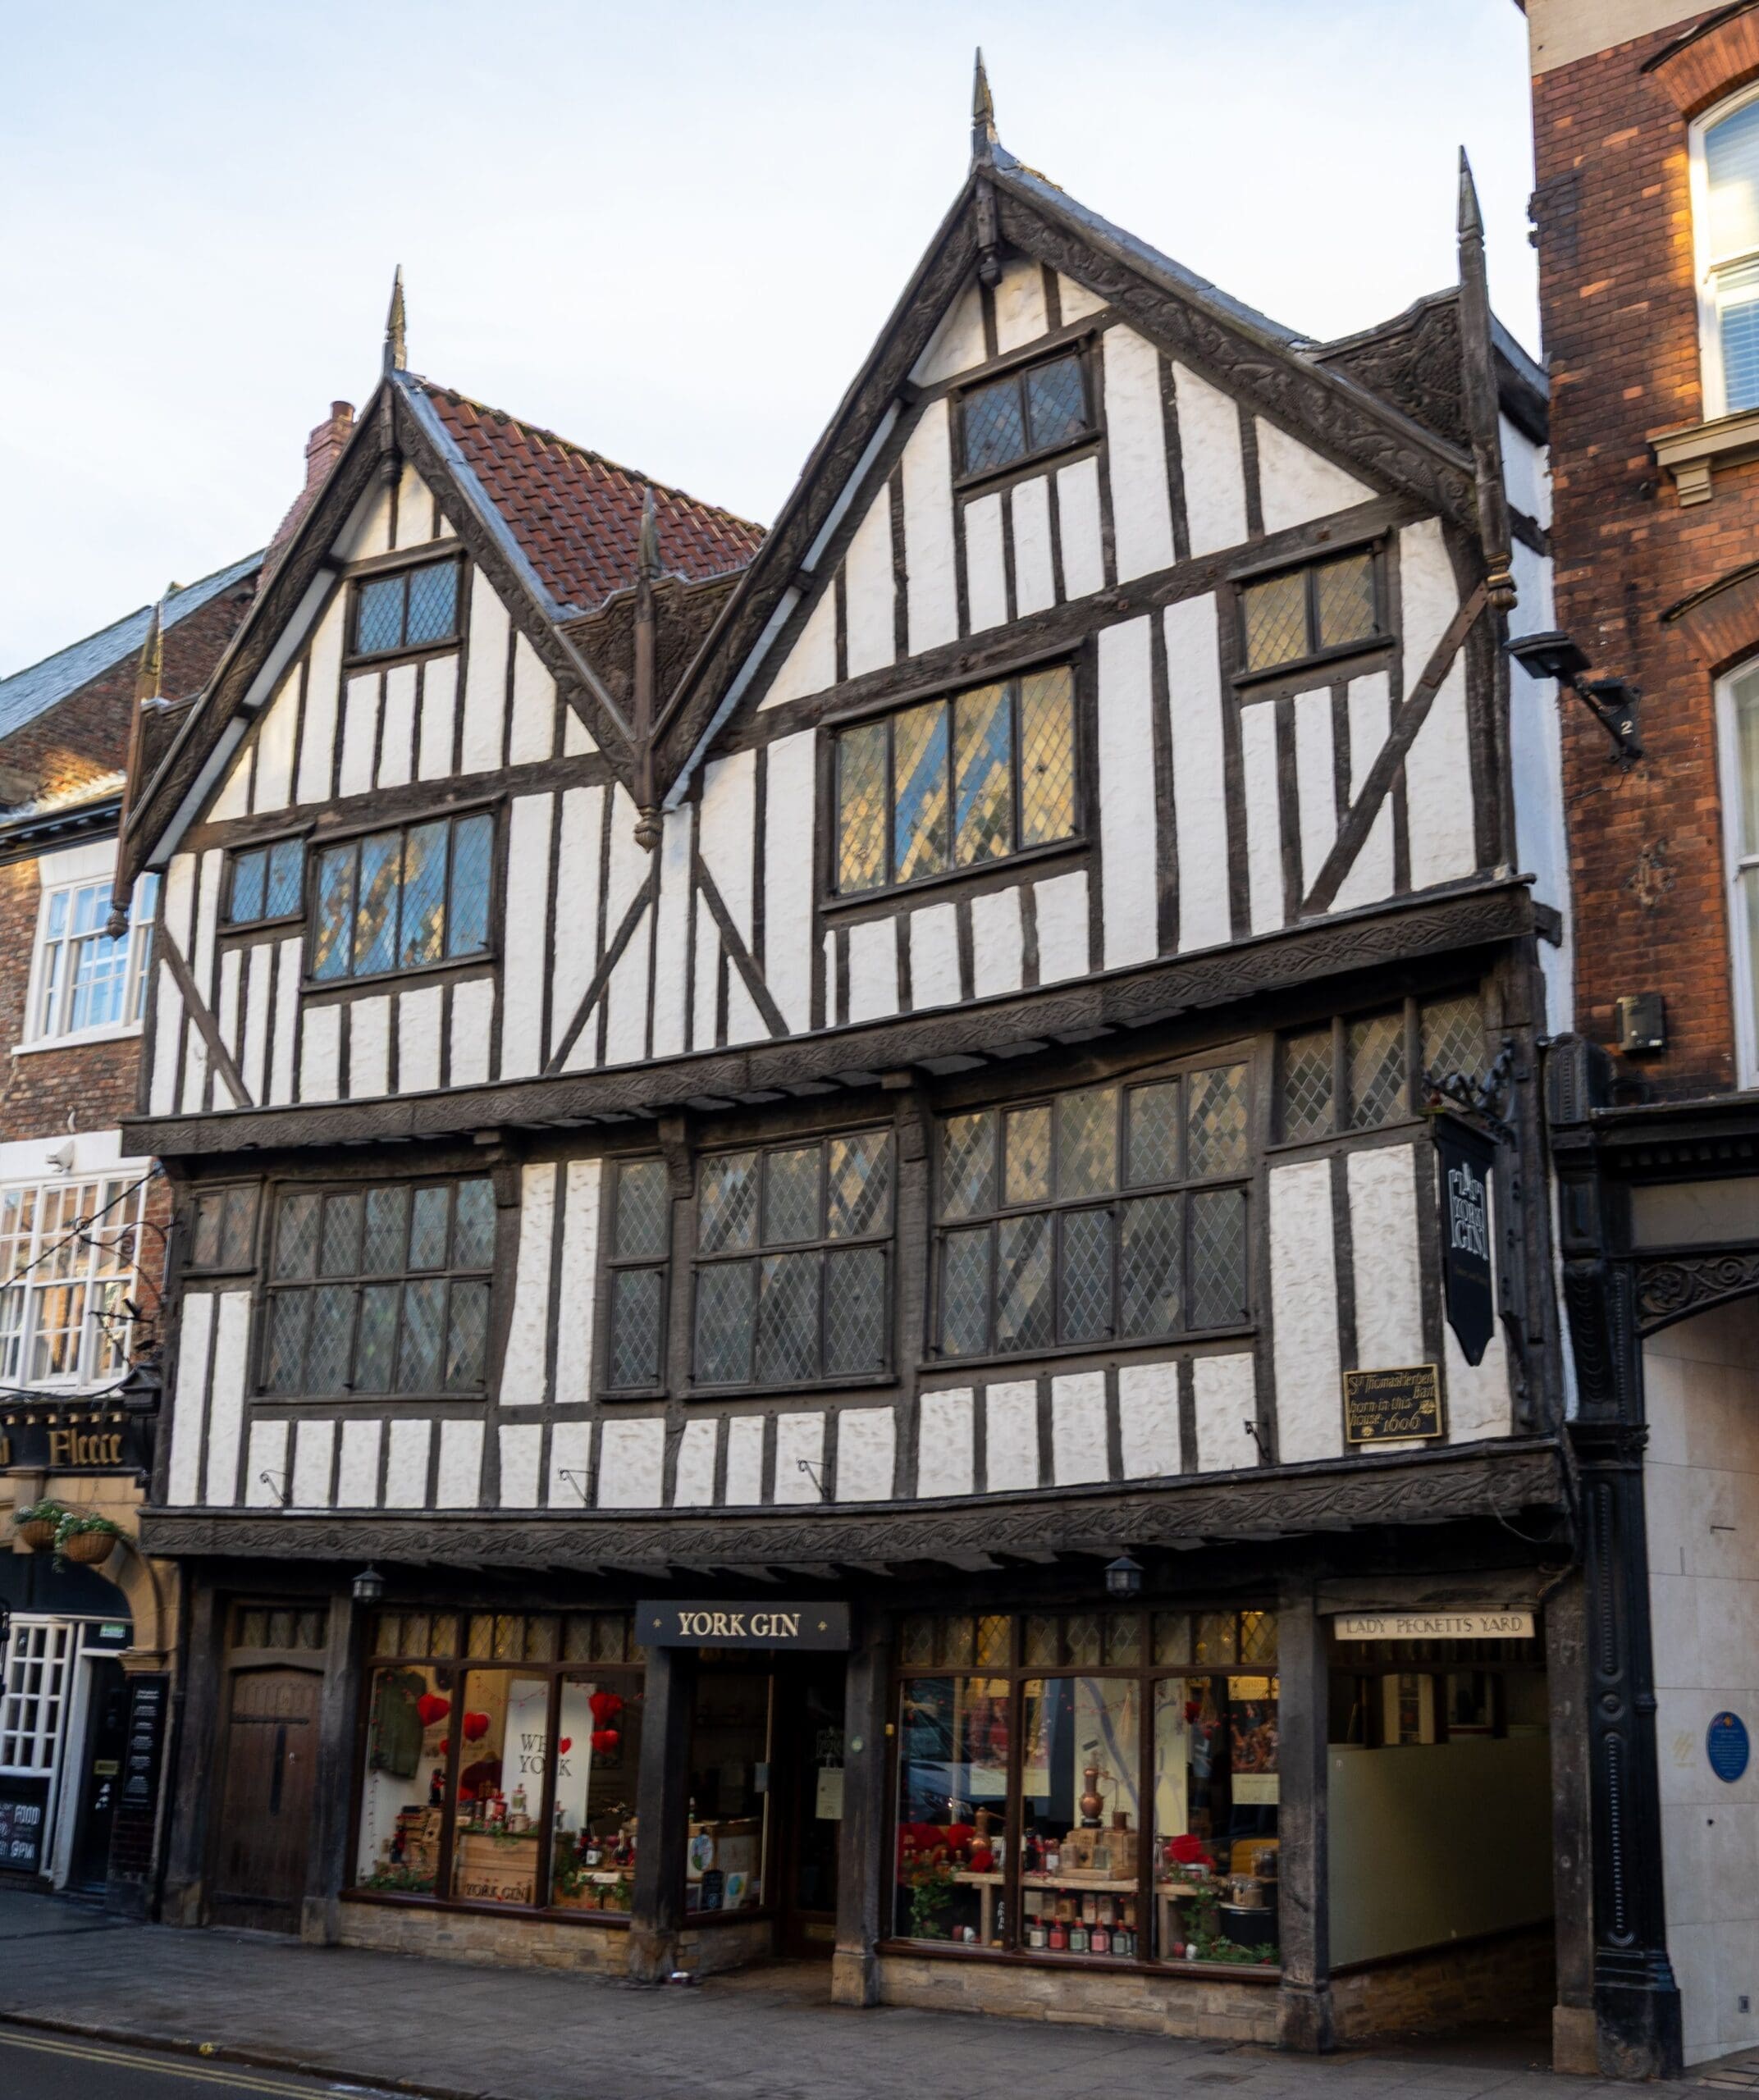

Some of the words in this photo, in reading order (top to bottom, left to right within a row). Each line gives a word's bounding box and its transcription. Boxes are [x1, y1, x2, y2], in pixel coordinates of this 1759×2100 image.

[1620, 720, 1634, 735] 2
[1453, 1195, 1484, 1232] YORK
[1455, 1221, 1488, 1261] GIN
[1350, 1399, 1377, 1413] born
[1378, 1398, 1390, 1411] in
[1391, 1395, 1413, 1410] this
[1350, 1413, 1382, 1426] house
[1382, 1412, 1421, 1432] 1606
[47, 1427, 123, 1466] Fleece
[677, 1612, 747, 1637] YORK
[750, 1613, 801, 1637] GIN
[1346, 1619, 1386, 1634] LADY
[1480, 1616, 1524, 1632] YARD
[521, 1733, 547, 1753] WE
[519, 1755, 572, 1777] YOK
[14, 1805, 40, 1826] FOOD
[466, 1883, 498, 1897] YORK
